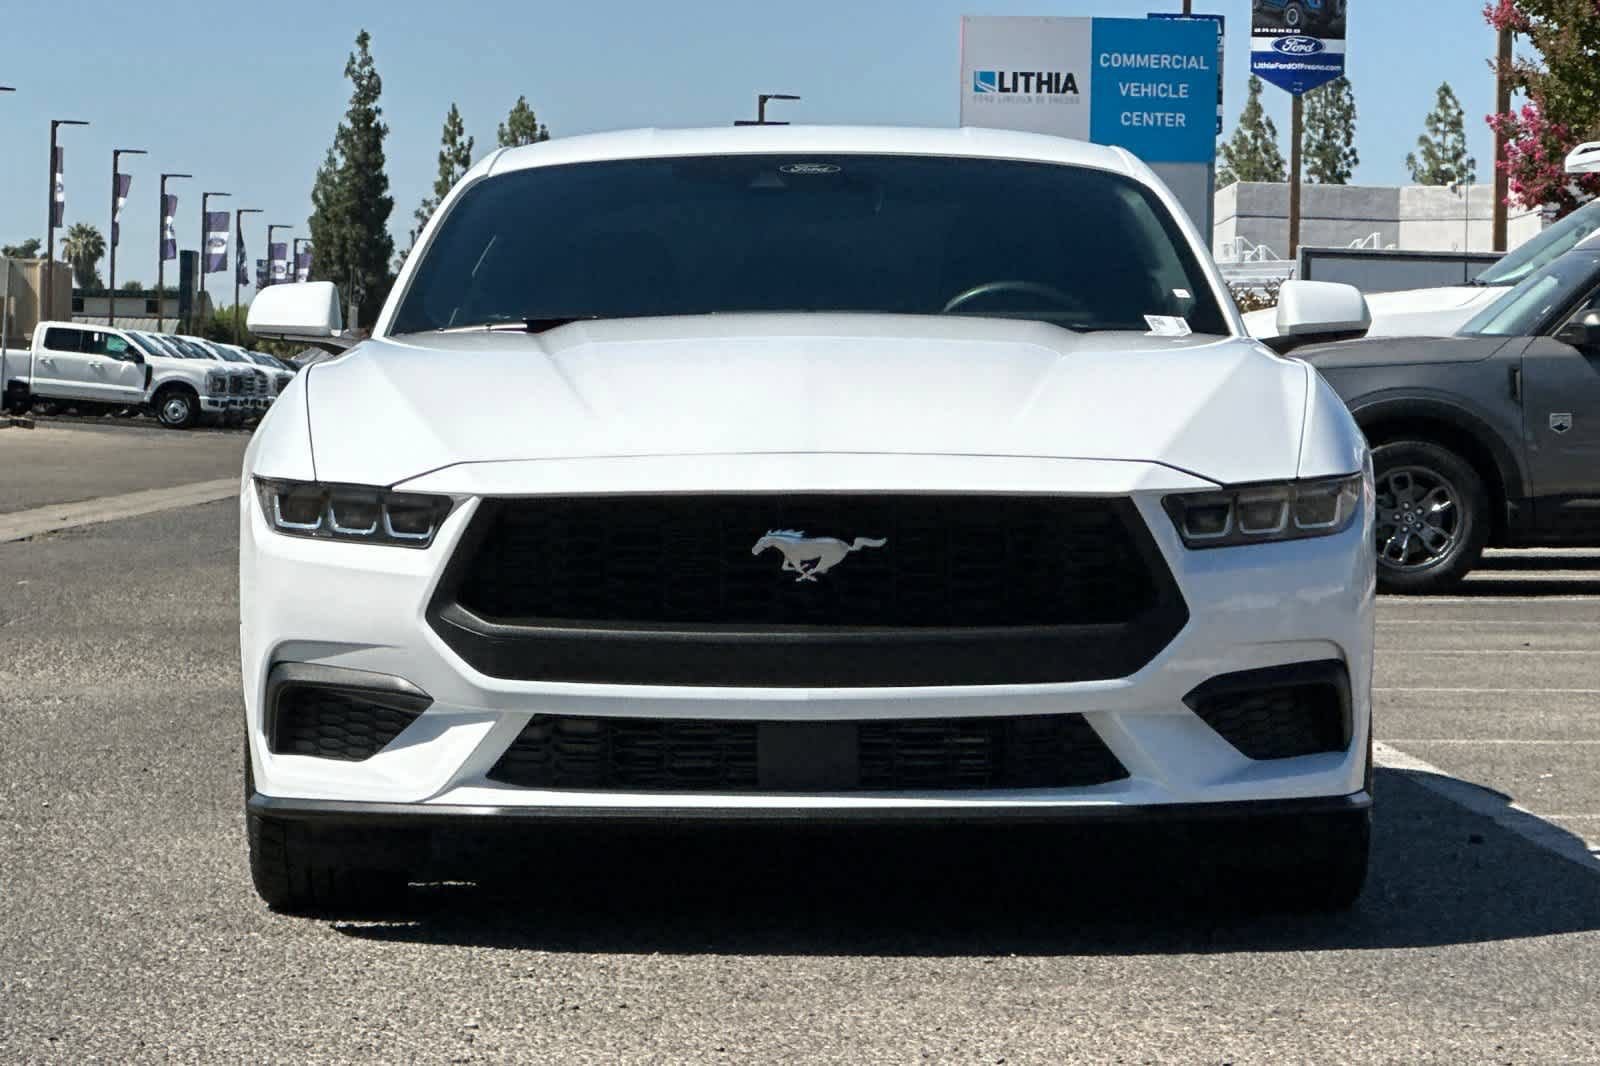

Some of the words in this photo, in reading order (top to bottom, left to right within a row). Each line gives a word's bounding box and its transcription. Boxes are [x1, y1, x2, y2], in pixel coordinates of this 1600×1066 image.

[1282, 37, 1316, 53] Ford
[1100, 53, 1209, 70] COMMERCIAL
[998, 71, 1080, 94] LITHIA
[1119, 82, 1190, 98] VEHICLE
[1121, 112, 1187, 127] CENTER
